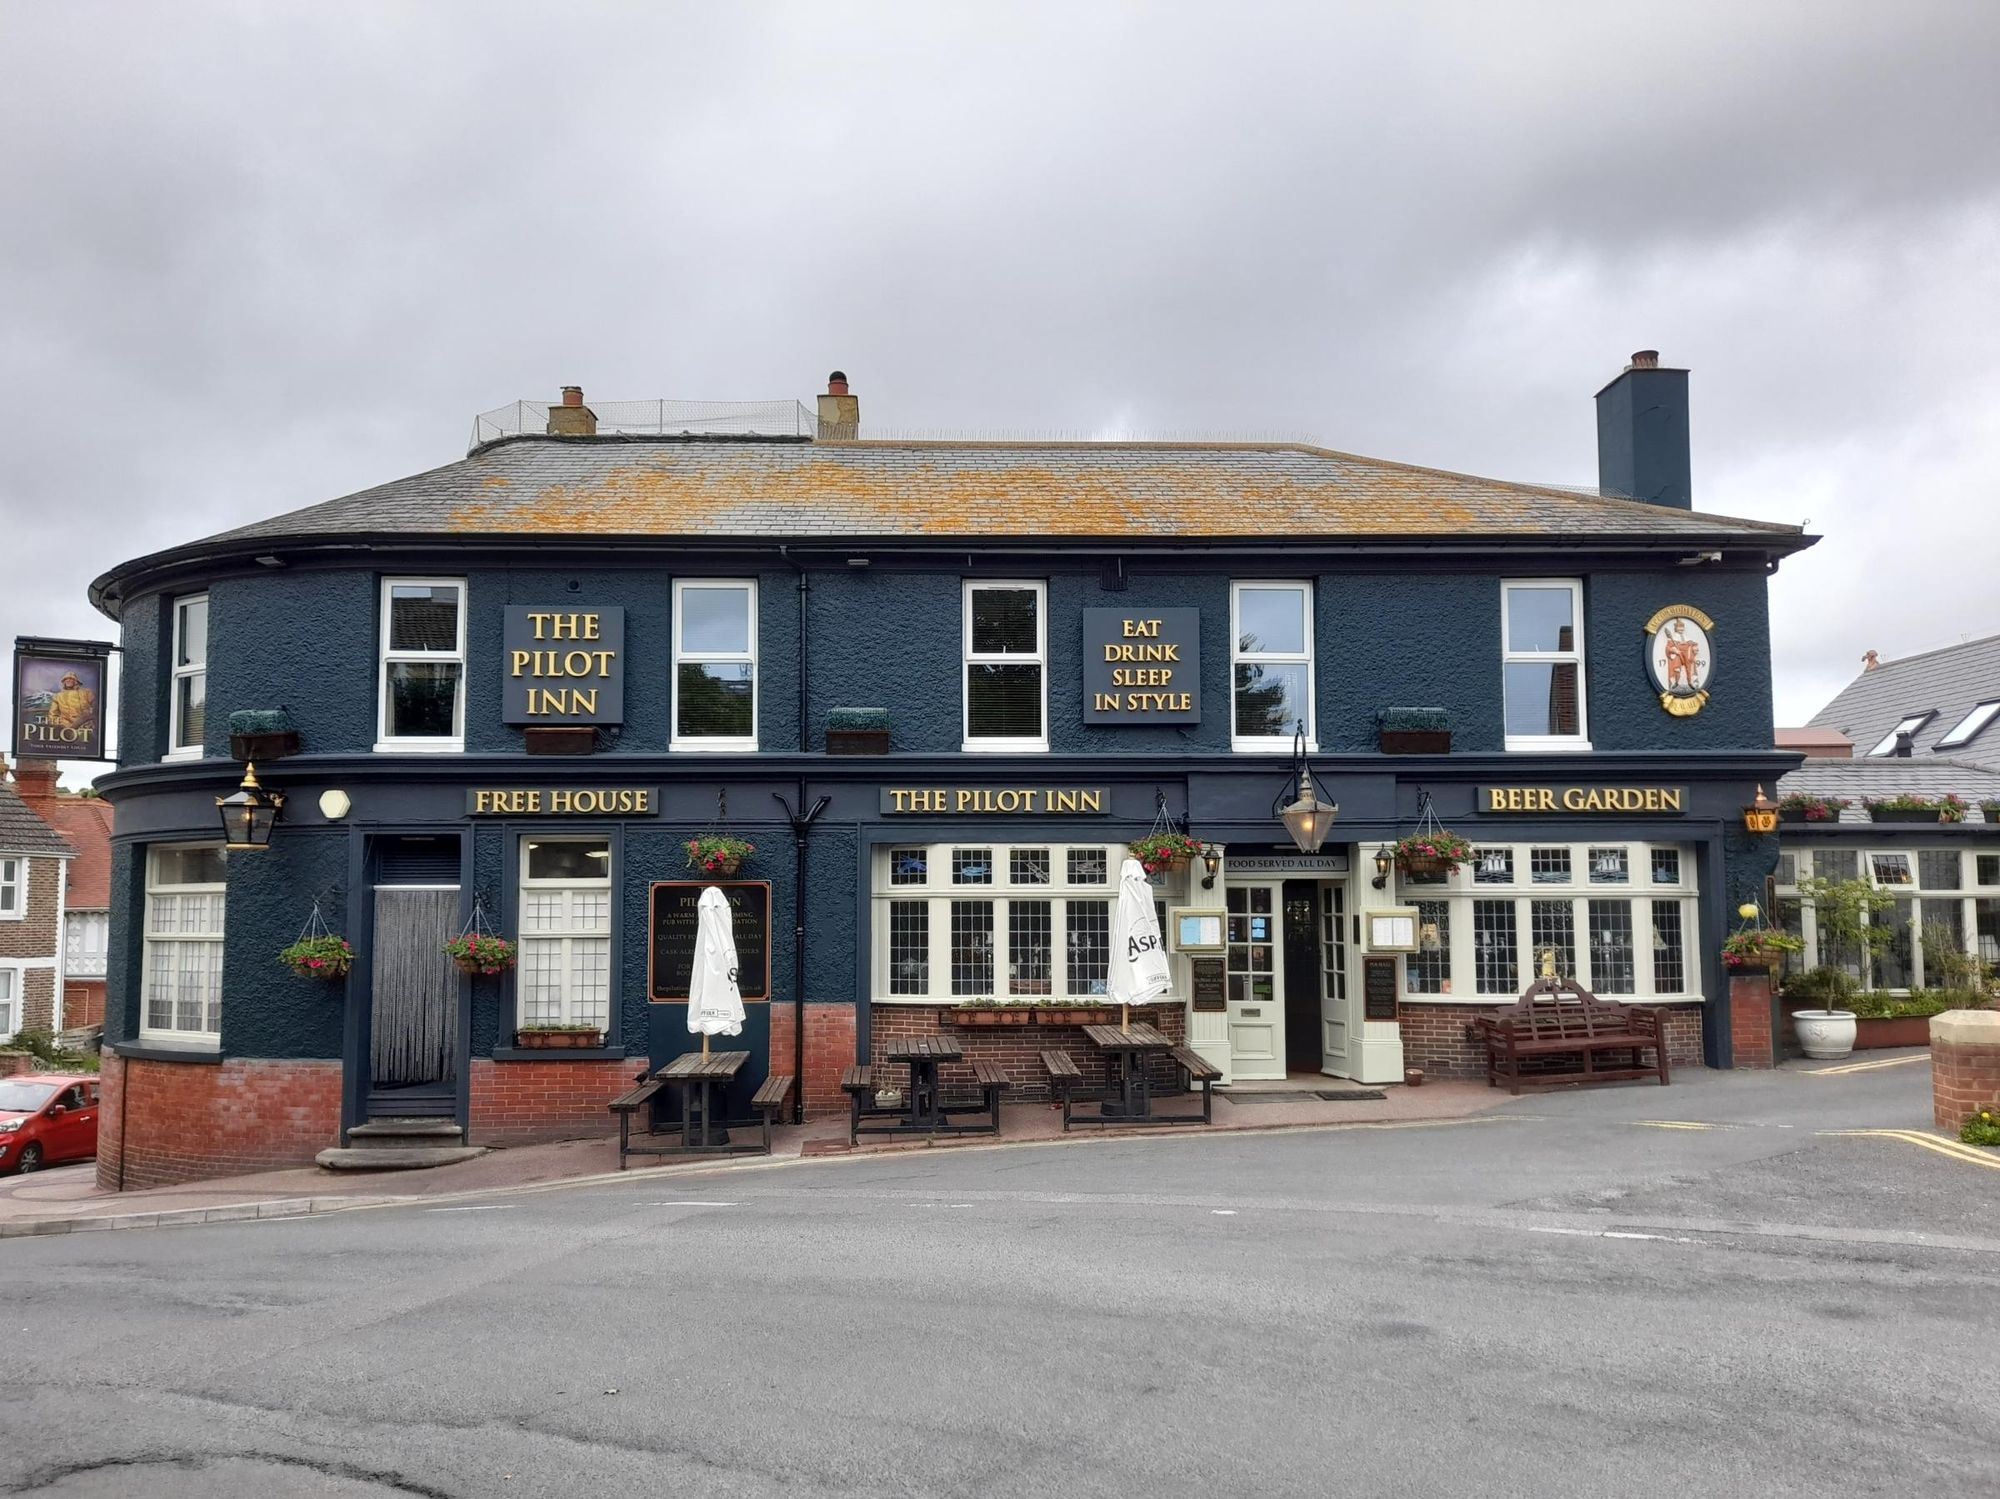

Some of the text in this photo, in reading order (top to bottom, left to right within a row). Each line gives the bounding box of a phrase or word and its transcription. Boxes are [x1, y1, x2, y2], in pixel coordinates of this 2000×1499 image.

[527, 613, 600, 640] THE
[1122, 619, 1162, 637] EAT
[1104, 644, 1180, 662] DRINK
[511, 650, 616, 677] PILOT
[1112, 669, 1172, 686] SLEEP
[526, 688, 598, 715] INN
[1094, 693, 1191, 711] IN STYLE
[24, 723, 93, 742] PILOT
[475, 790, 648, 813] FREE HOUSE
[890, 789, 1101, 812] THE PILOT INN
[1489, 788, 1681, 810] BEER GARDEN
[1228, 859, 1337, 868] FOOD SERVED ALL DAY
[680, 897, 698, 907] PIL
